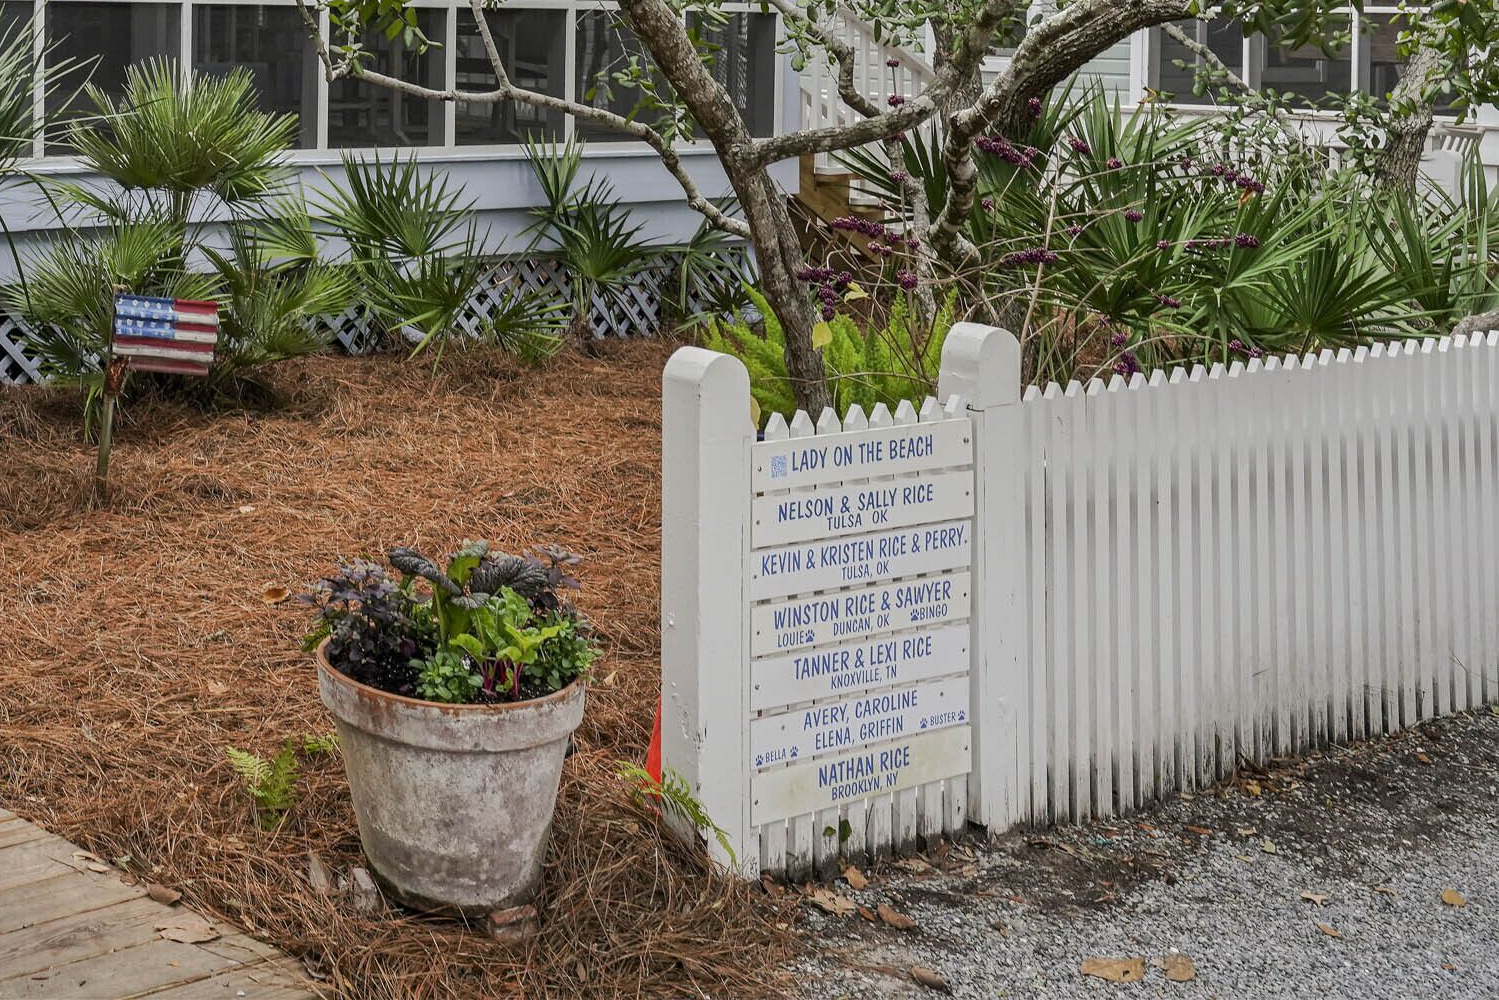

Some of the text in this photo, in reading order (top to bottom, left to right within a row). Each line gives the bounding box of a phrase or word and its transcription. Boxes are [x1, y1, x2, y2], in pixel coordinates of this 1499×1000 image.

[792, 435, 933, 472] LADY ON THE BEACH
[778, 484, 933, 522] NELSON & SALLY RICE
[827, 509, 888, 530] TULSA OK
[762, 549, 800, 576] KEVIN
[806, 550, 815, 569] &
[821, 539, 873, 566] KRISTEN
[879, 535, 906, 558] RICE
[912, 534, 920, 552] &
[877, 560, 889, 575] OK
[774, 580, 951, 630] WINSTON RICE & SAWYER
[920, 604, 948, 620] BINGO
[877, 613, 889, 627] OK
[777, 630, 804, 648] LOUIE
[794, 636, 932, 681] TANNER & LEXI RICE
[886, 665, 897, 678] TN
[855, 690, 918, 719] CAROLINE
[860, 715, 903, 740] GRIFFIN
[930, 712, 956, 726] BUSTER
[765, 748, 786, 763] BELLA
[818, 746, 910, 788] NATHAN RICE
[886, 771, 898, 786] NY
